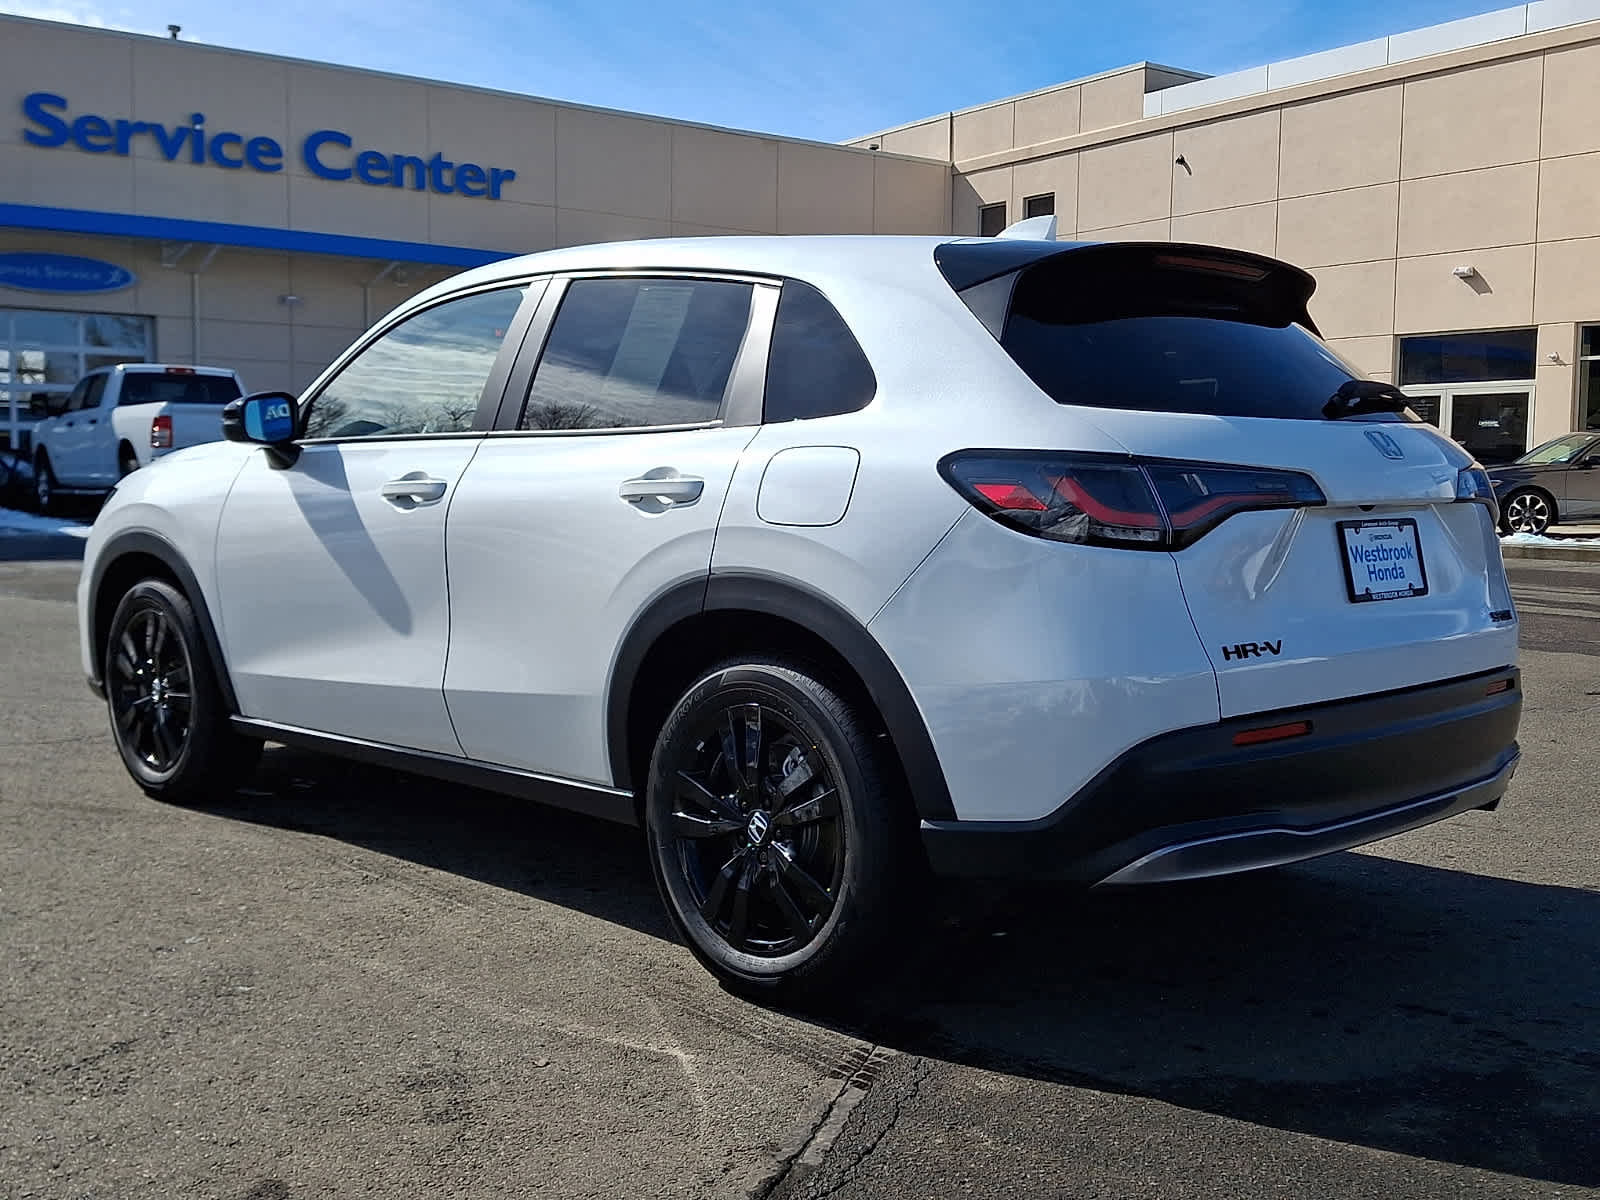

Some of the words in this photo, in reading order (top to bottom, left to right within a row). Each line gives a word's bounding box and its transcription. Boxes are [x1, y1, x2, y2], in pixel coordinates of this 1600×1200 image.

[22, 92, 283, 172] Service
[304, 130, 516, 200] Center
[1350, 542, 1414, 563] Westbrook
[1367, 562, 1406, 582] Honda
[1222, 640, 1281, 661] HR-V
